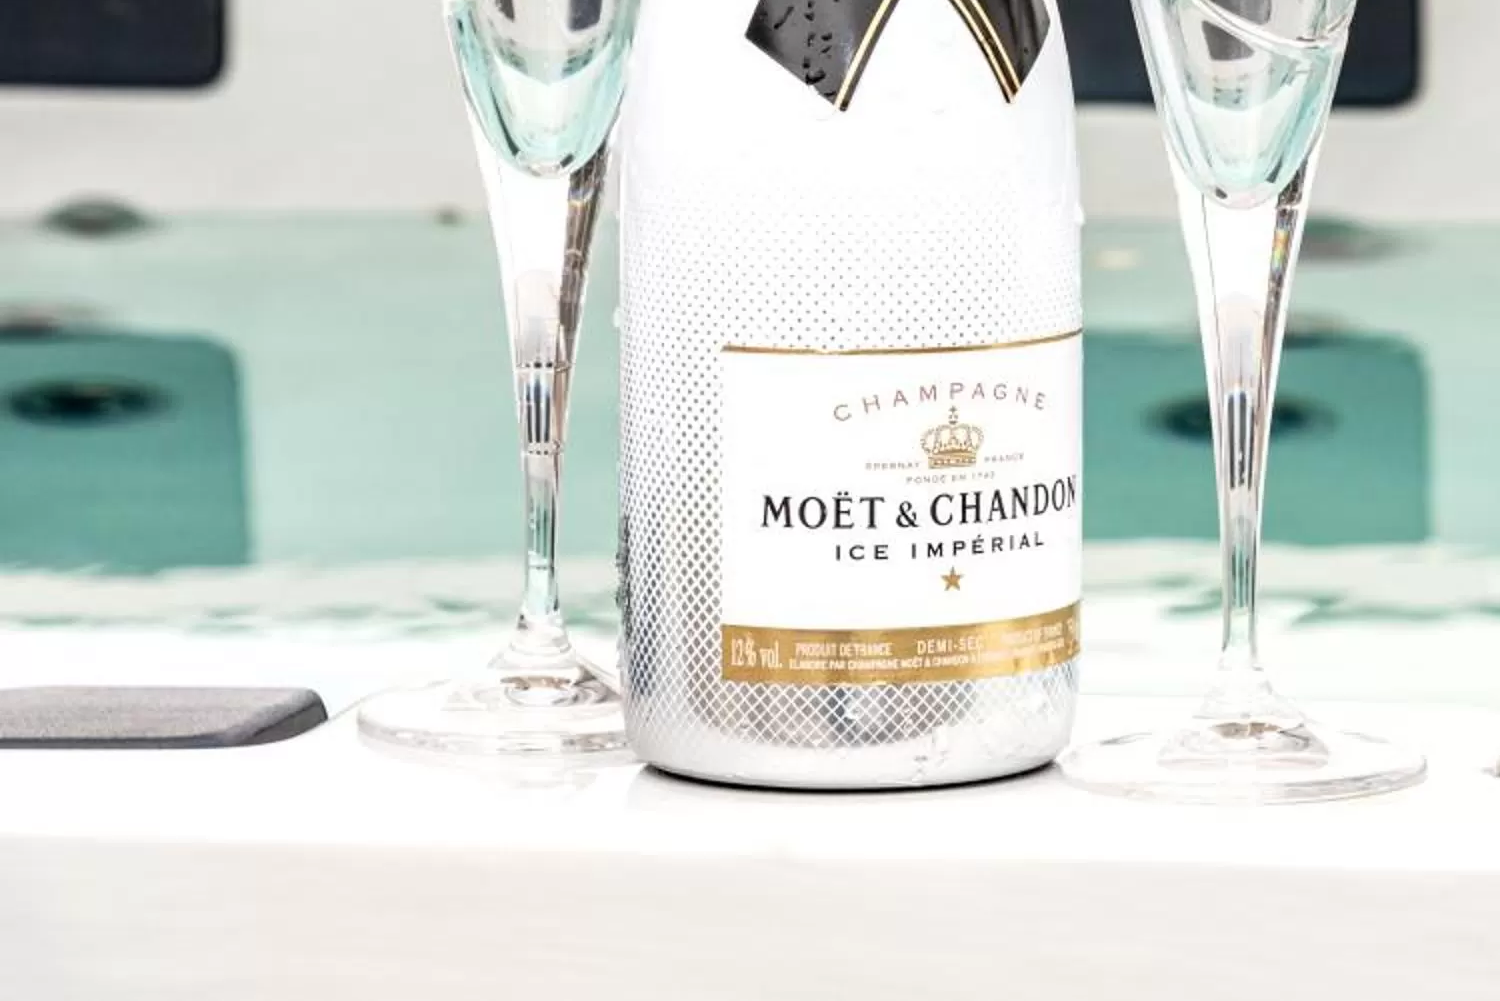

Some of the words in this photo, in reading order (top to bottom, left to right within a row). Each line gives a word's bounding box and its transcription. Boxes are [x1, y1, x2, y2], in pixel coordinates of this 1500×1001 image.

[833, 381, 1046, 422] CHAMPAGNE
[761, 490, 886, 529] MOËT
[895, 500, 919, 528] &
[929, 475, 1079, 528] CHANDON
[834, 544, 889, 561] ICE
[910, 530, 1045, 560] IMPÉRIAL
